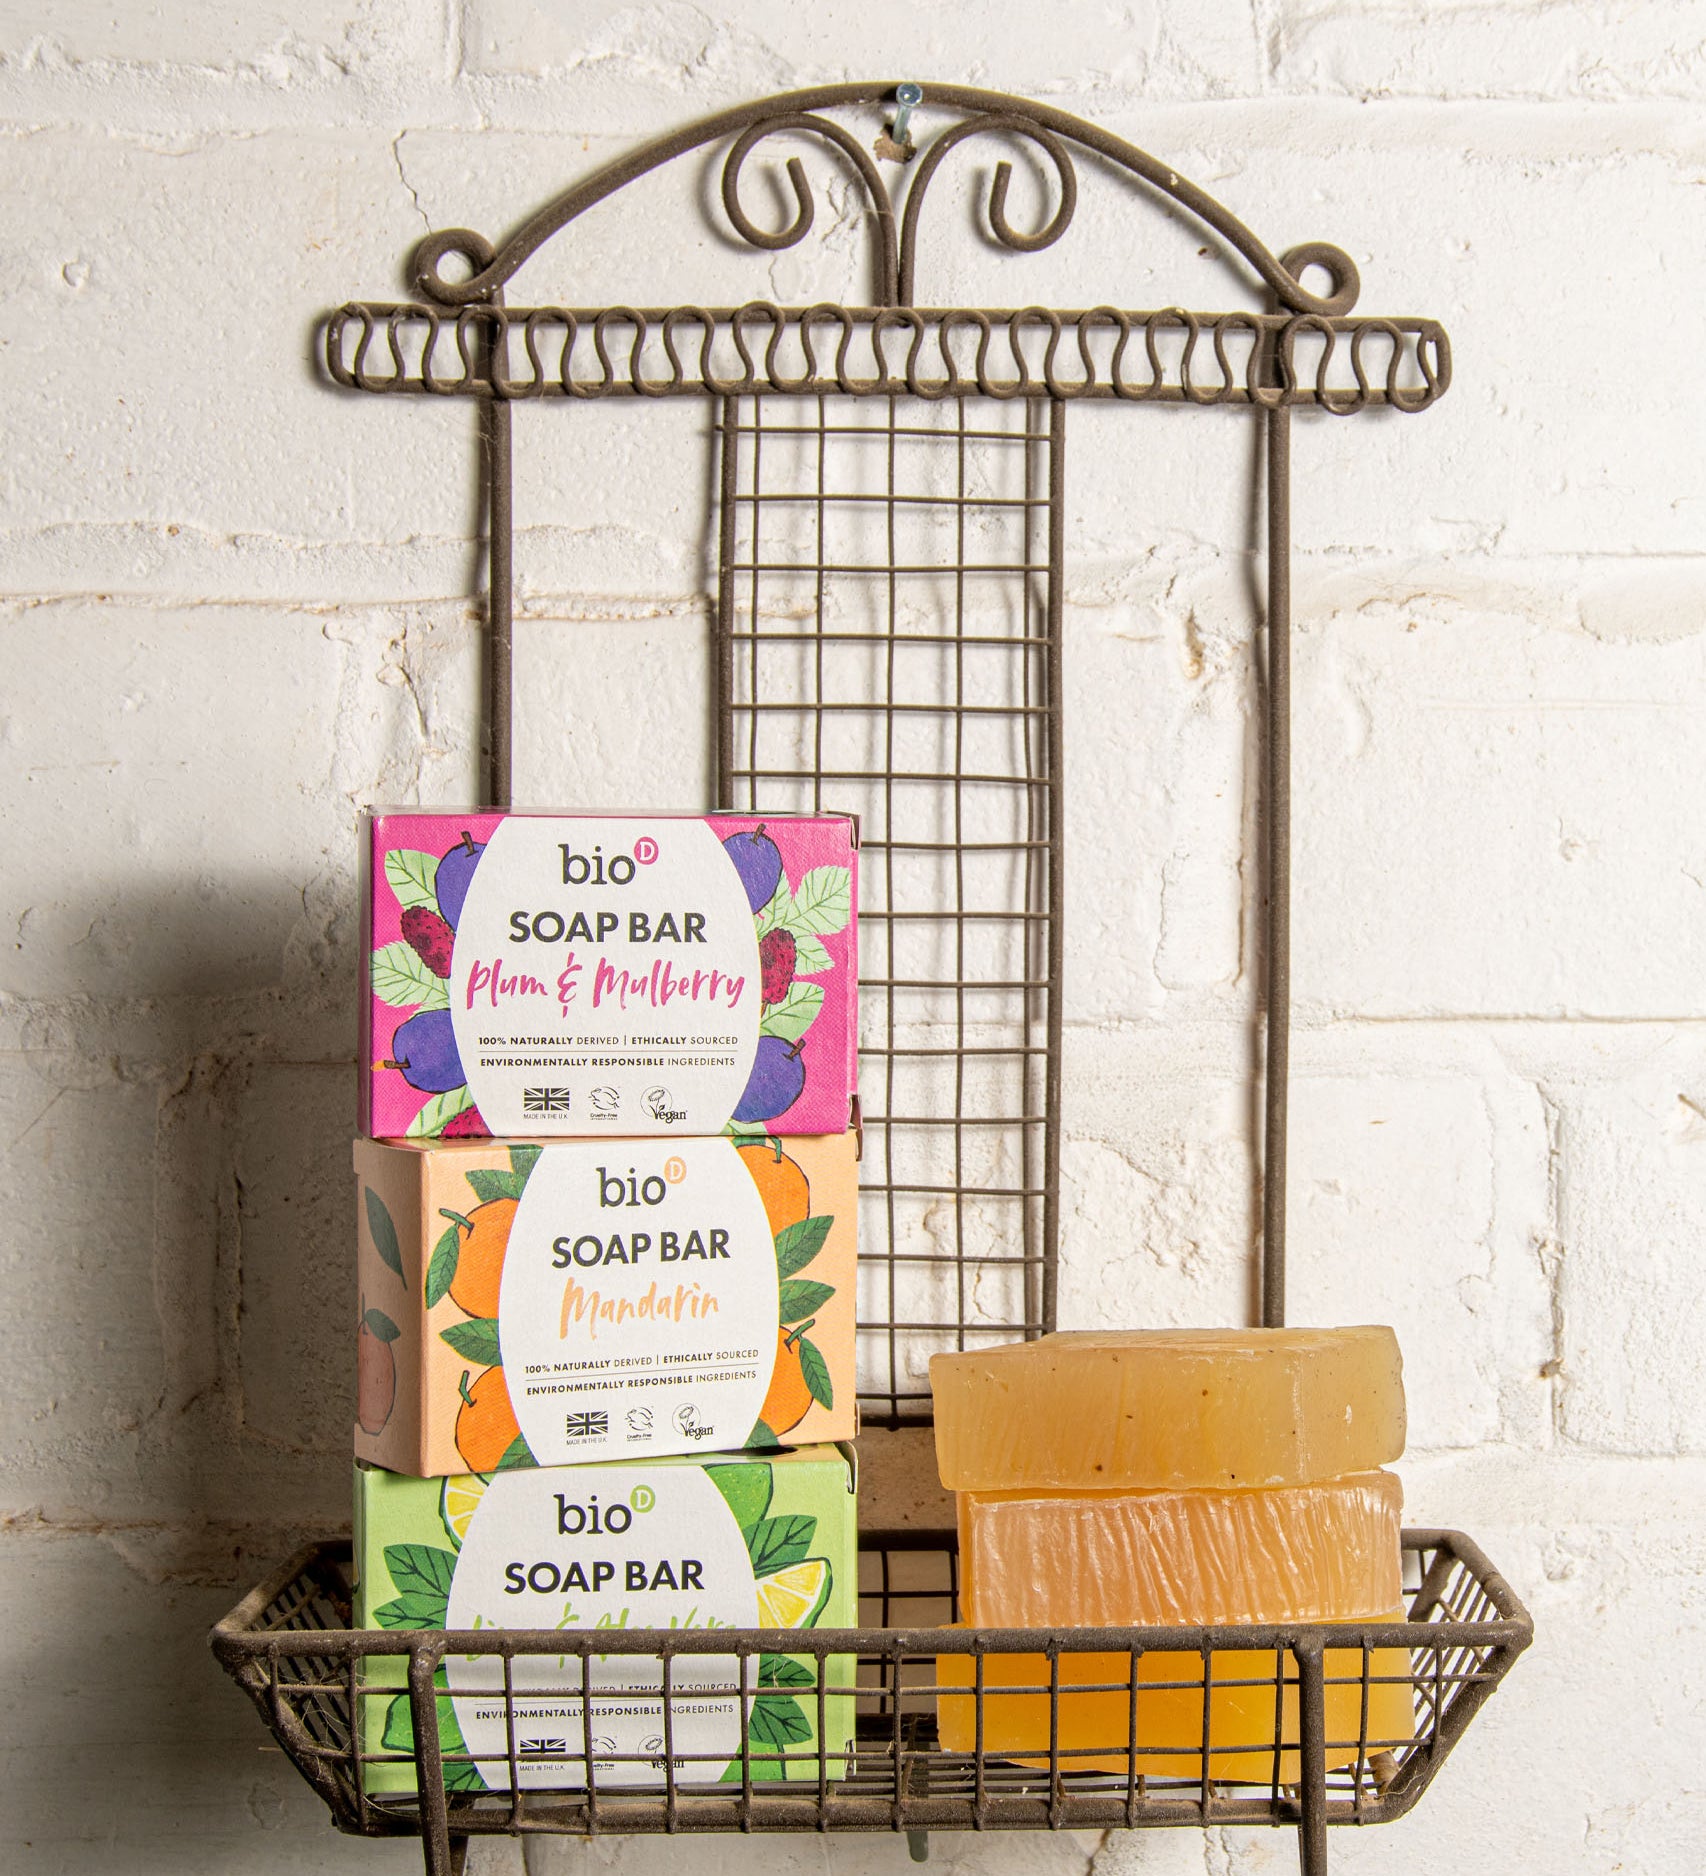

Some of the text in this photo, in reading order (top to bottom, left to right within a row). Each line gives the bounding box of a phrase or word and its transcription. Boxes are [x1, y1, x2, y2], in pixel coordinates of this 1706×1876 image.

[508, 911, 708, 943] SOAP BAR
[466, 951, 746, 1019] Plum & Mulberry
[478, 1036, 738, 1046] 100% NATURALLY DERIVED ETHICALLY SOURCED
[480, 1057, 735, 1067] ENVIRONMENTALLY RESPONSIBLE INGREDIENTS
[652, 1107, 687, 1124] Vegan
[551, 1229, 731, 1269] SOAP BAR
[559, 1276, 719, 1341] Mandarin
[525, 1349, 759, 1374] 100% NATURALLY DERIVED ETHICALLY SOURCED
[526, 1370, 757, 1396] ENVIRONMENTALLY RESPONSIBLE INGREDIENTS
[681, 1423, 714, 1440] Vegan
[503, 1559, 705, 1595] SOAP BAR
[671, 1704, 734, 1714] NGREDIENTS
